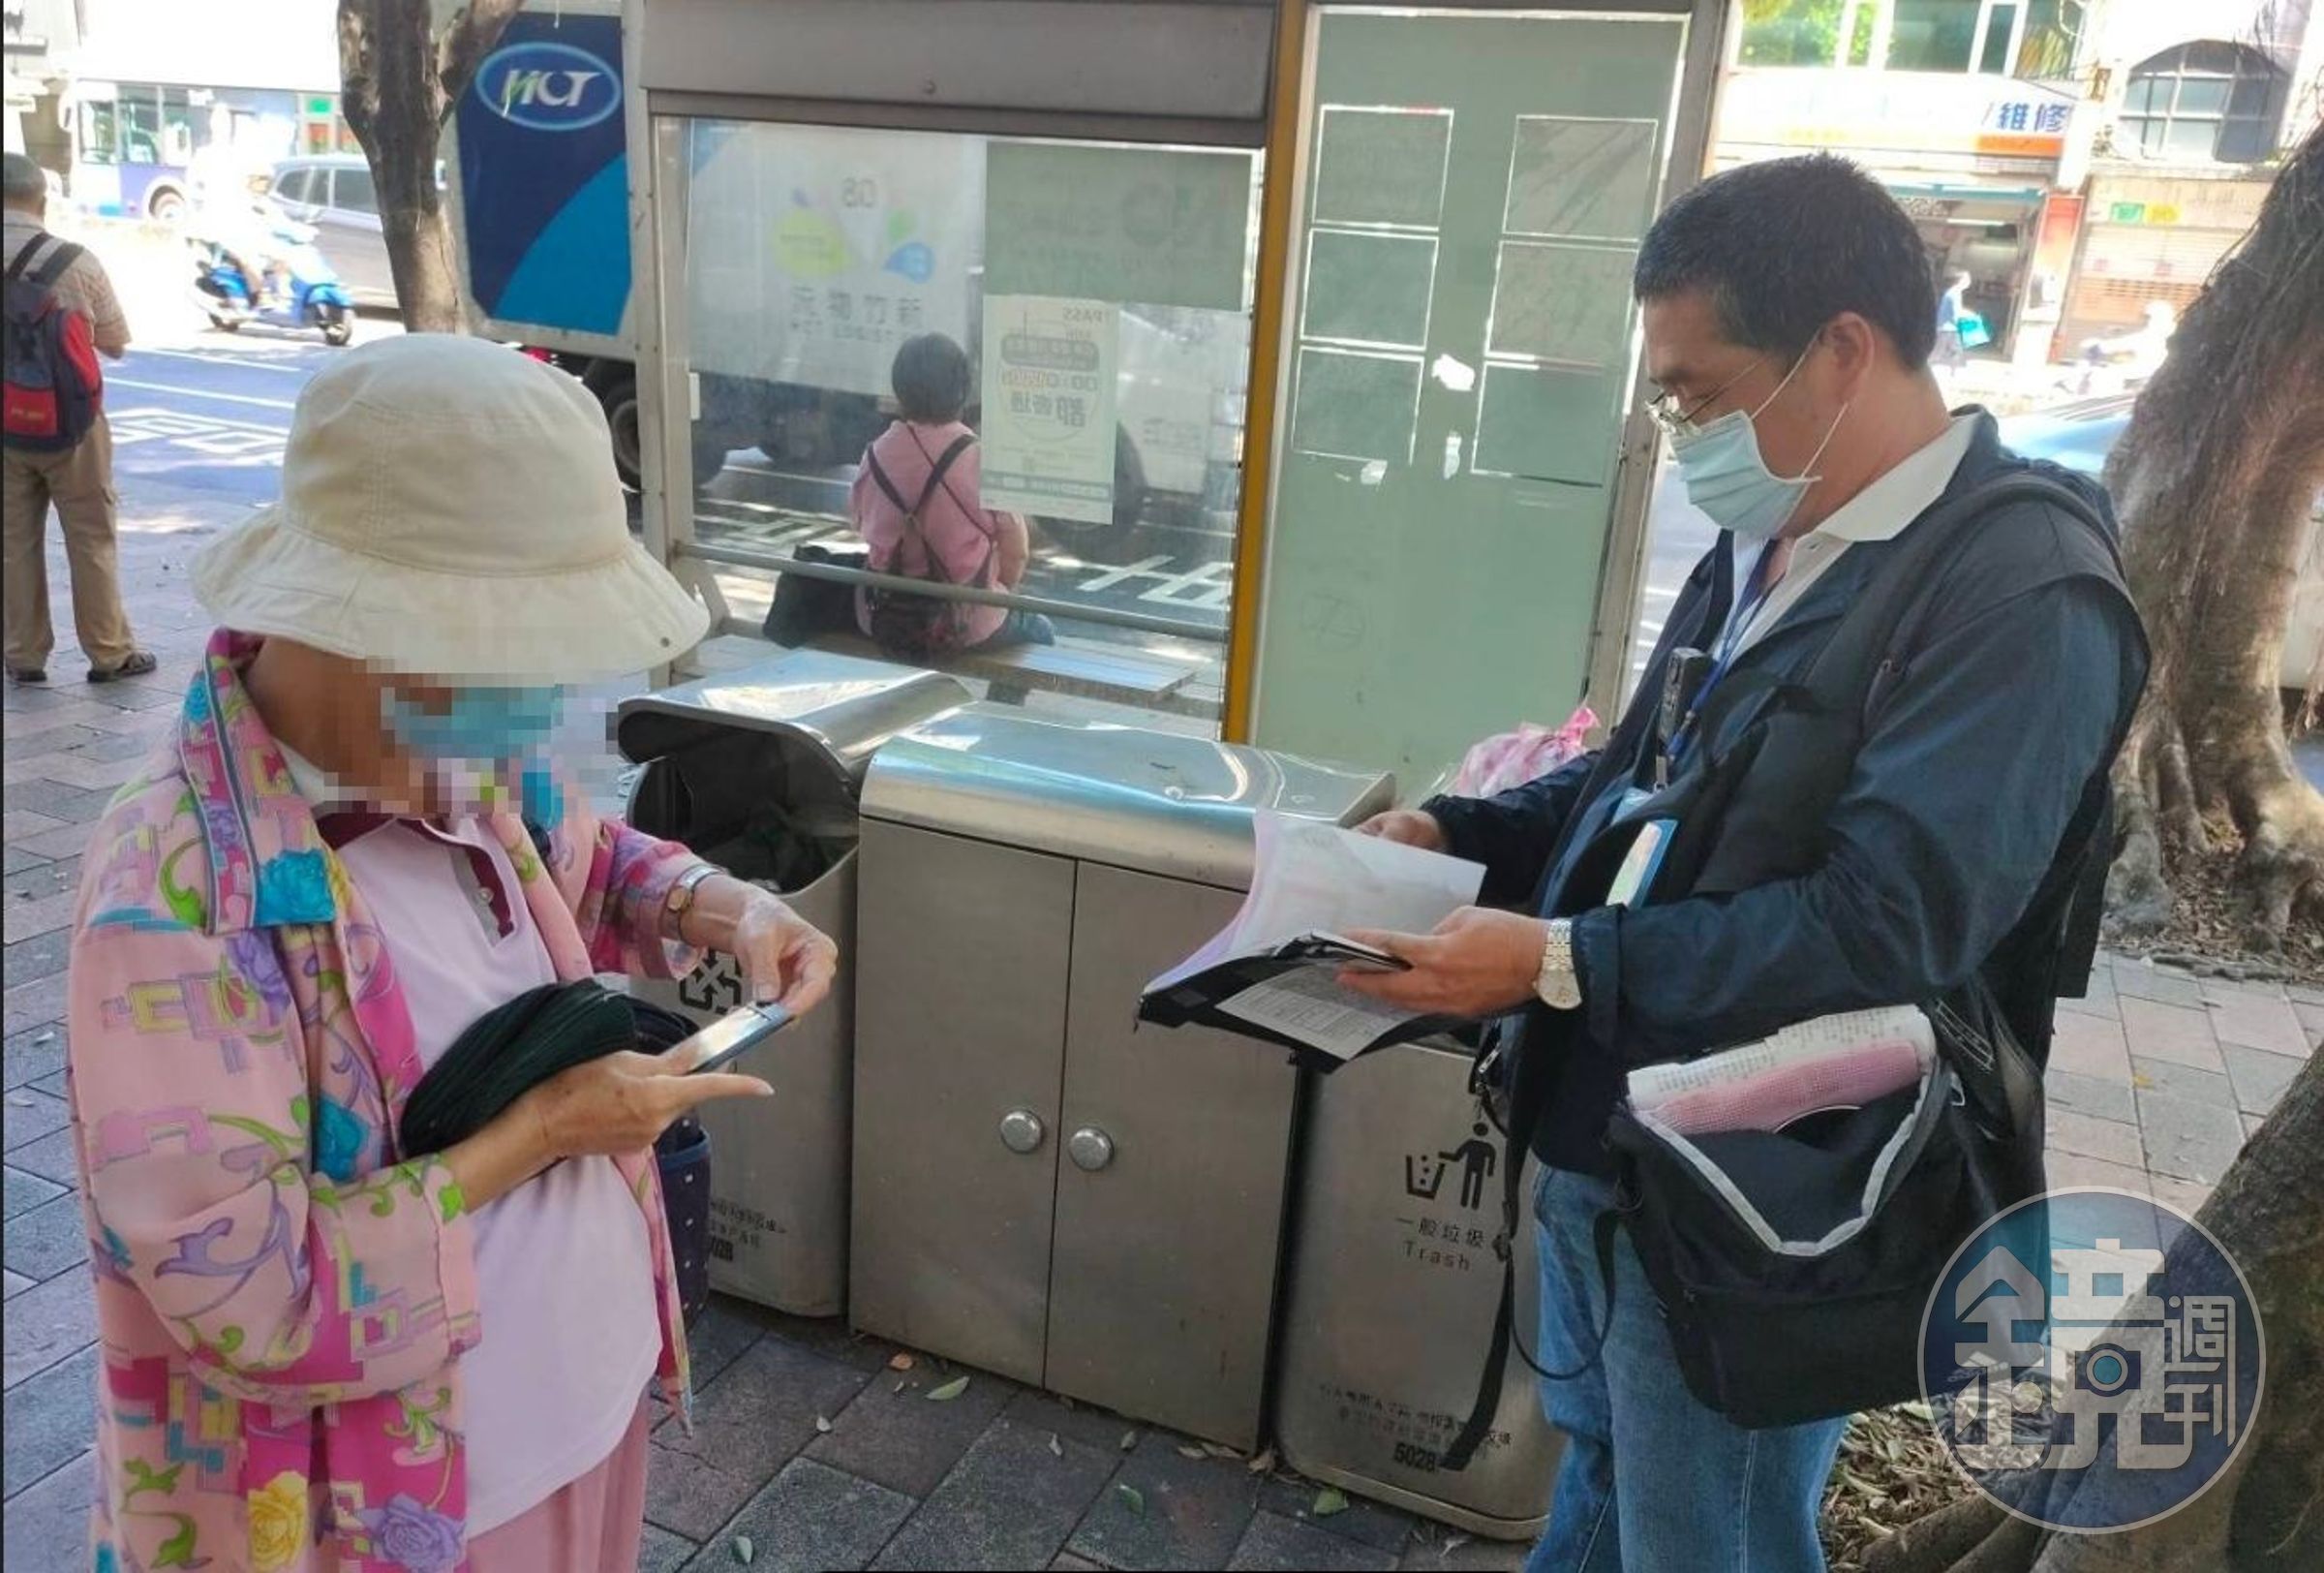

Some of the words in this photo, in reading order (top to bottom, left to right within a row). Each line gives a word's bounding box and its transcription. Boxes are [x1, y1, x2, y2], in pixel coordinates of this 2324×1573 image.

[1396, 1217, 1484, 1248] 一般垃圾
[1403, 1240, 1470, 1271] Trash
